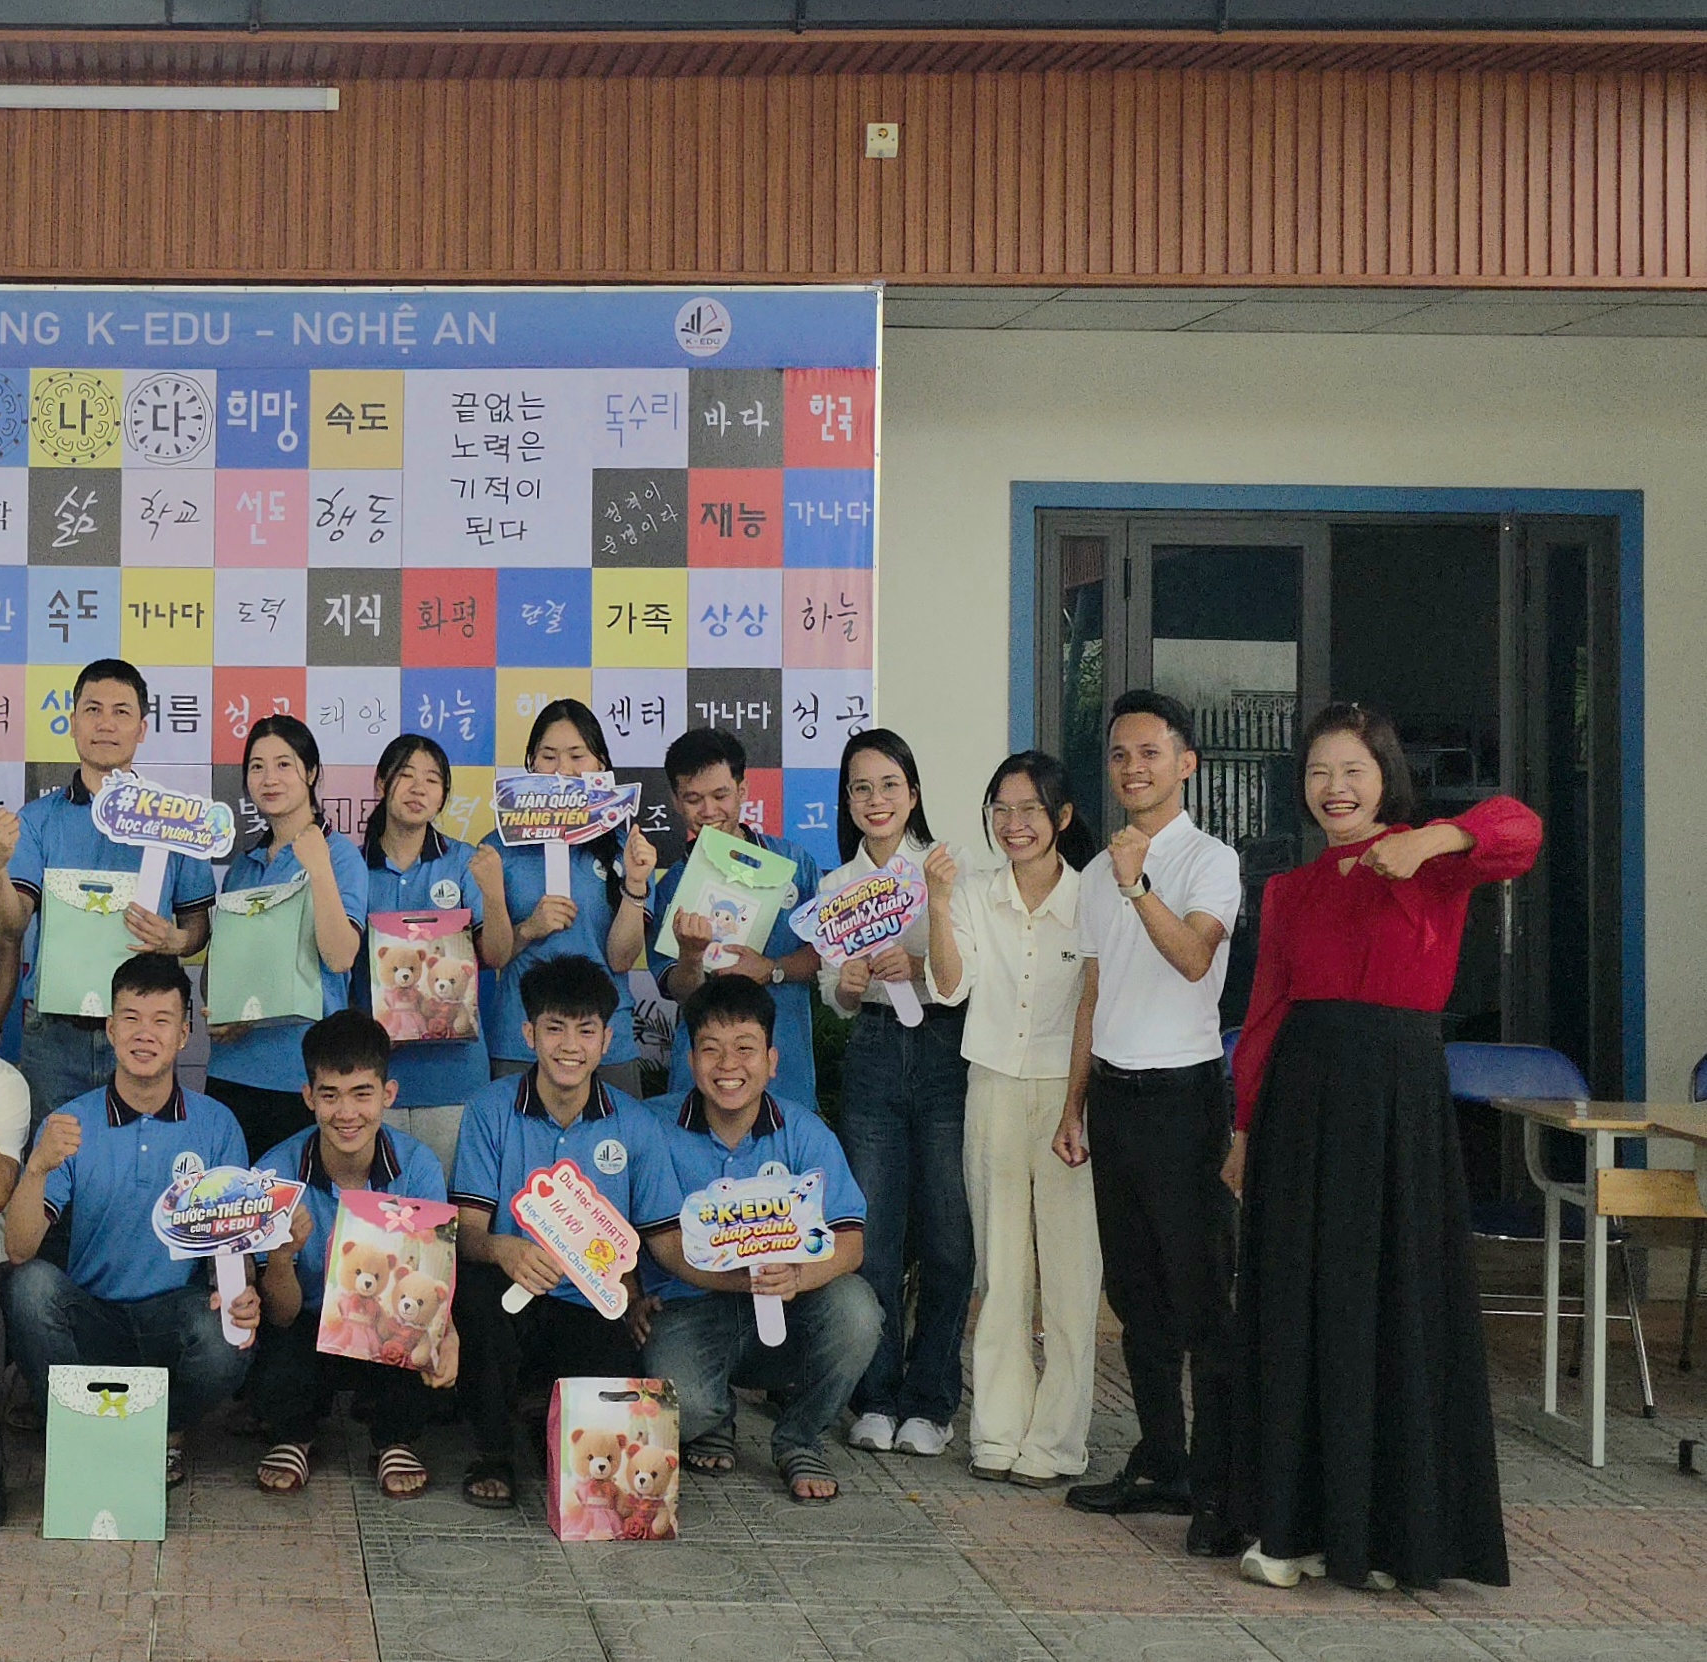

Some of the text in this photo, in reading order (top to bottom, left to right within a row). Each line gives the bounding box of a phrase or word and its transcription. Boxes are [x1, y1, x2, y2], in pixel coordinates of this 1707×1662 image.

[87, 311, 231, 346] K-EDU
[293, 302, 418, 354] NGHỆ
[431, 311, 497, 346] AN
[58, 399, 94, 436] 나
[151, 401, 187, 438] 다
[226, 389, 299, 452] 희망
[325, 402, 389, 435] 속도
[451, 391, 546, 423] 끝없는
[606, 392, 678, 448] 독수리
[704, 401, 770, 438] 바다
[809, 394, 853, 442] 한국
[451, 430, 545, 463] 노력은
[450, 476, 541, 504] 기적이
[51, 486, 99, 548] 삶
[140, 489, 201, 541] 학교
[235, 490, 286, 545] 선도
[315, 487, 395, 544] 행동
[466, 516, 528, 546] 된다
[699, 502, 768, 538] 재능
[788, 500, 872, 527] 가나다
[47, 589, 99, 643] 속도
[127, 601, 205, 629] 가나다
[239, 597, 286, 632] 도덕
[323, 594, 381, 637] 지식
[416, 595, 477, 638] 화평
[606, 602, 673, 635] 가족
[699, 603, 769, 637] 상상
[800, 592, 858, 643] 하늘
[418, 689, 477, 742] 하늘
[604, 694, 665, 738] 센터
[694, 700, 772, 730] 가나다
[115, 784, 203, 823] #K-EDU
[514, 788, 589, 809] HÀN QUỐC
[115, 814, 142, 835] học
[194, 831, 214, 846] xa
[521, 827, 562, 839] K-EDU
[553, 807, 591, 827] TIẾN
[868, 876, 899, 899] Bay
[816, 891, 914, 946] Thanh Xuân
[843, 914, 902, 956] K-EDU
[171, 1207, 206, 1226] BƯỚC
[205, 1208, 218, 1218] RA
[217, 1196, 243, 1219] THẾ
[189, 1216, 255, 1234] cùng K-EDU
[522, 1200, 540, 1222] Học
[549, 1199, 569, 1219] HÀ
[559, 1171, 630, 1250] Du Học KANATA
[698, 1196, 792, 1228] #K-EDU
